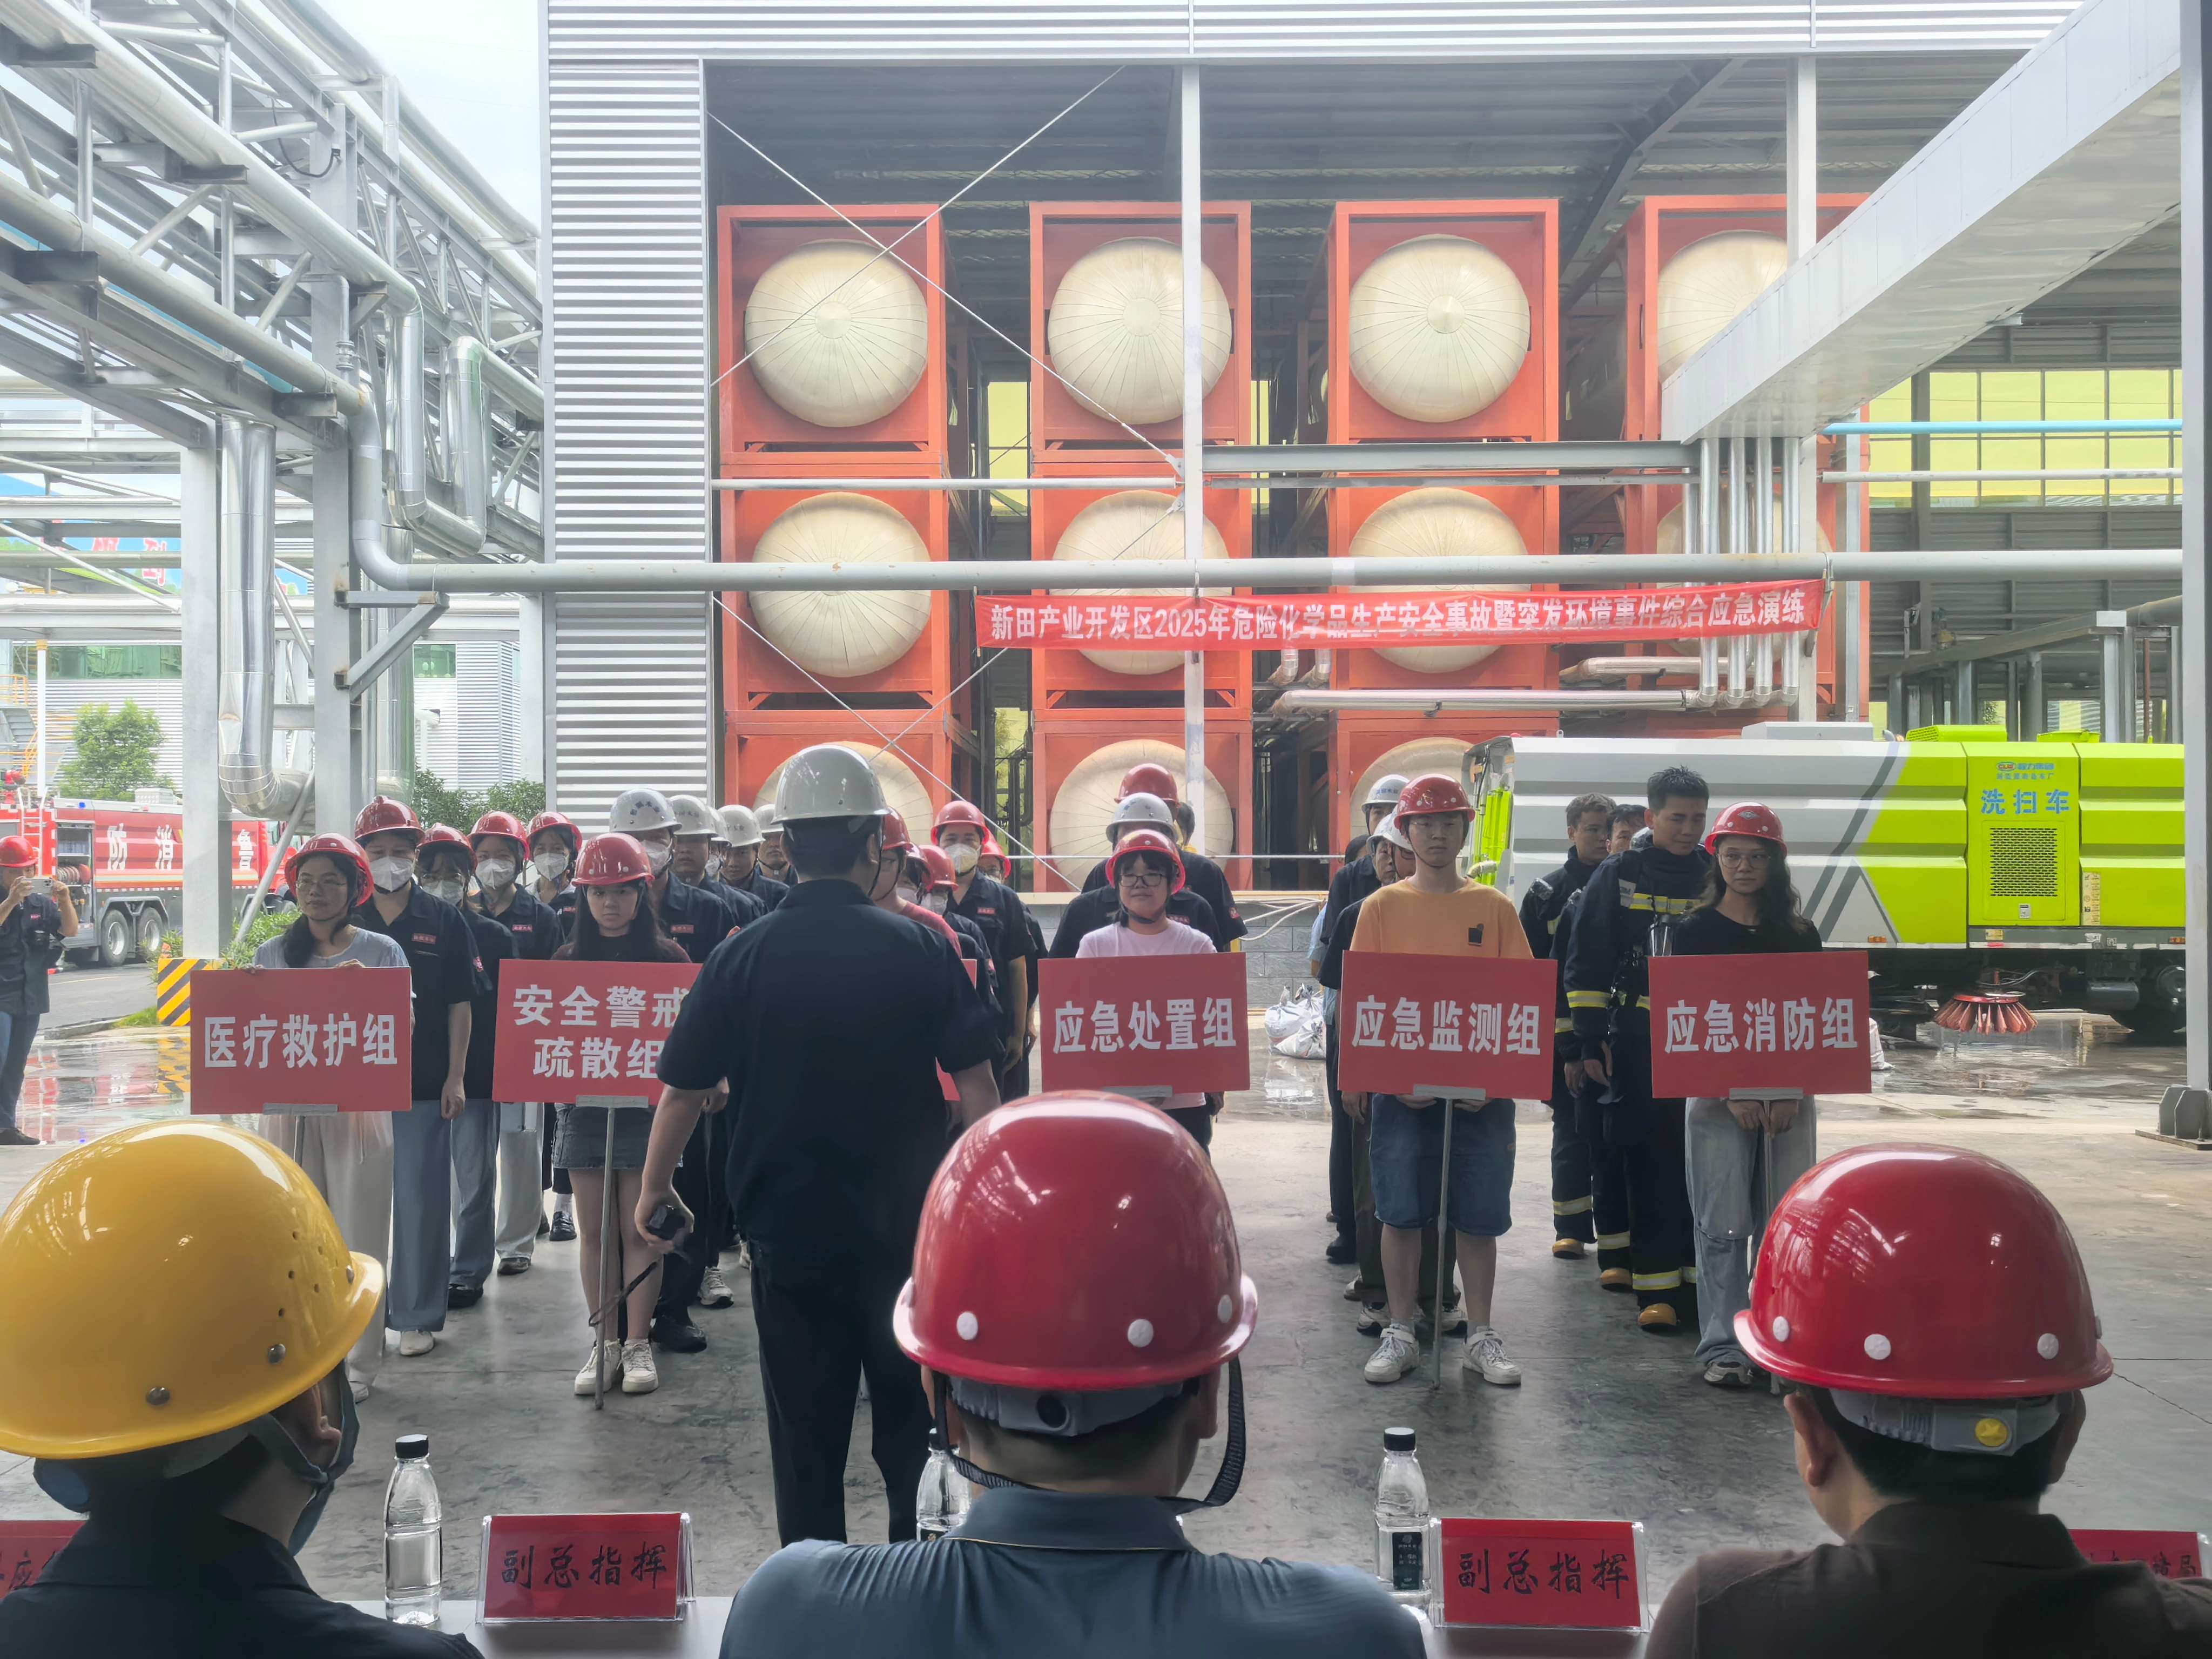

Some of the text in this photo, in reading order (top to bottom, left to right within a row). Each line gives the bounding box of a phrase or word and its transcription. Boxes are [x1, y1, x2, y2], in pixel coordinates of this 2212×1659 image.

[1981, 788, 2069, 814] 洗扫车
[205, 1013, 397, 1069] 医疗救护组
[1053, 996, 1237, 1054] 应急处置组
[1351, 994, 1541, 1055] 应急监测组
[1664, 997, 1858, 1054] 应急消防组
[533, 1036, 662, 1080] 疏散组
[501, 1540, 668, 1589] 副总指挥
[1458, 1549, 1629, 1599] 副总指挥
